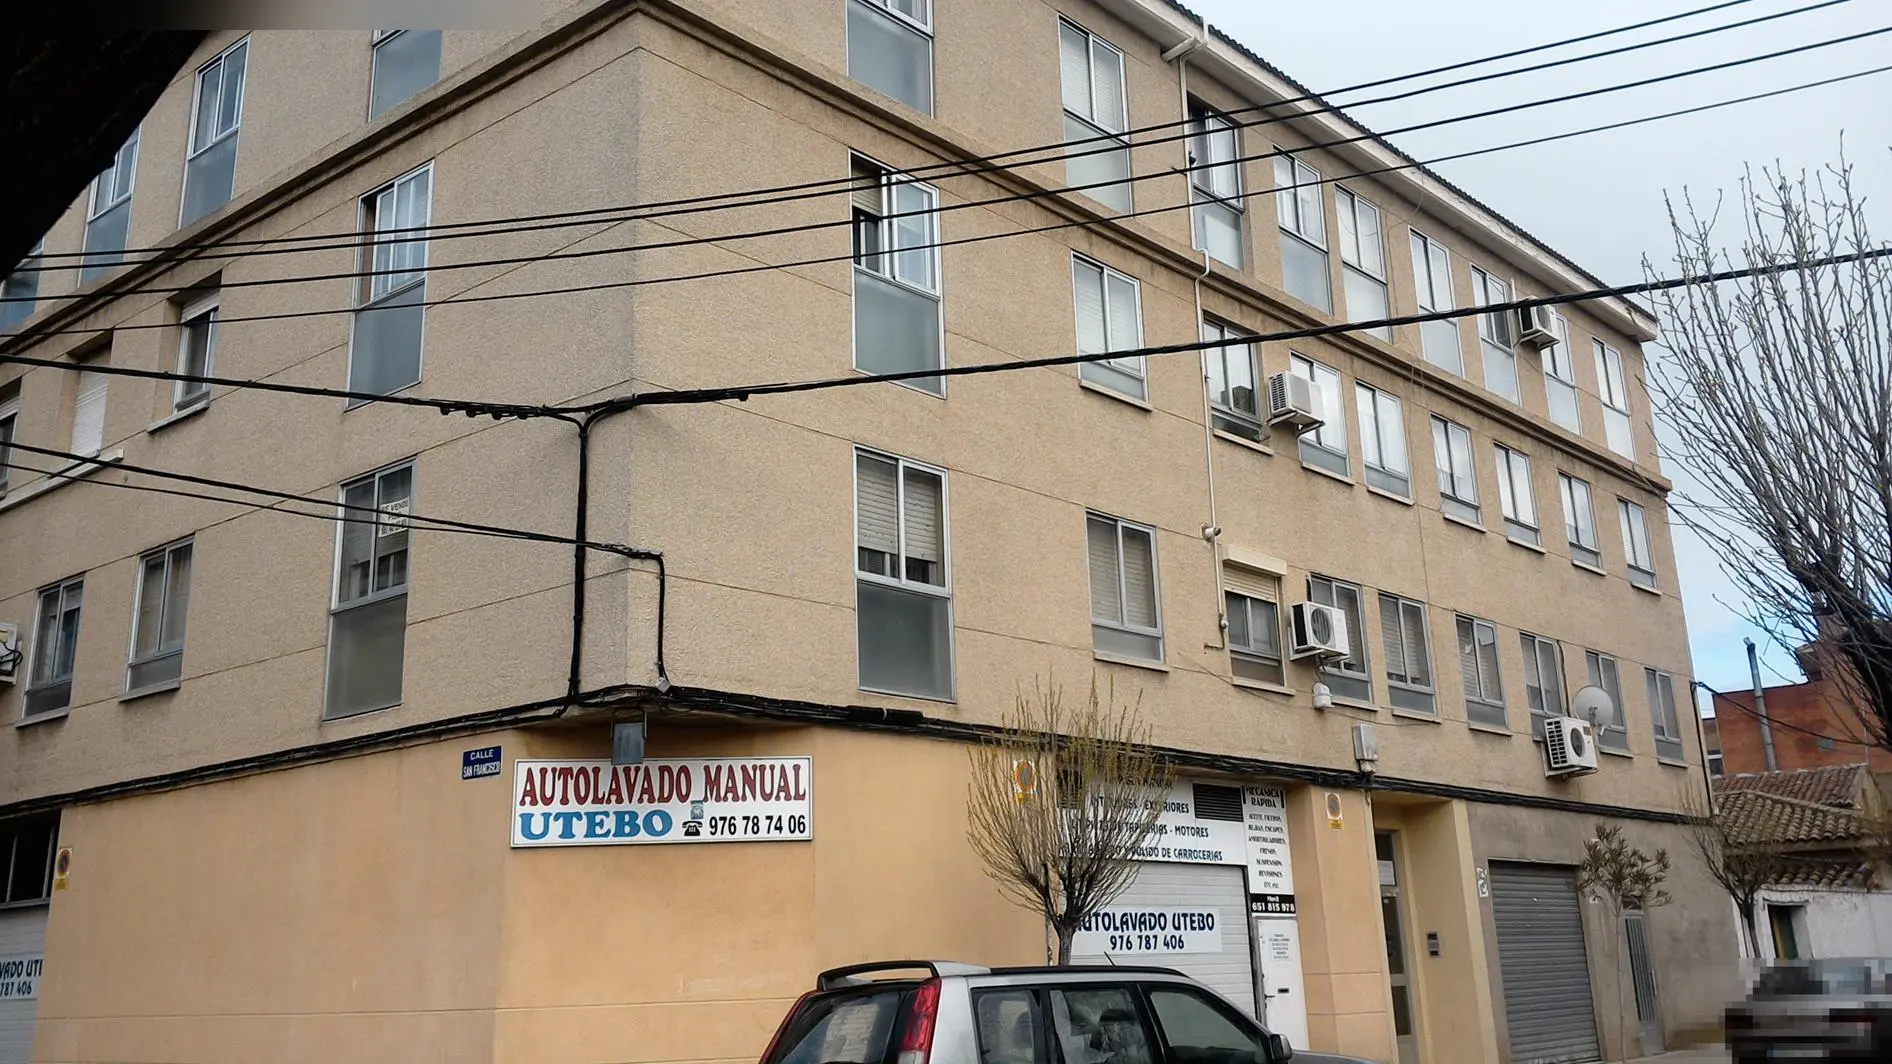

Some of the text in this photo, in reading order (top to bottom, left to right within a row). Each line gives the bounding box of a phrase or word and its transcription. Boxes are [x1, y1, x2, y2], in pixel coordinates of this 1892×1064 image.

[470, 749, 494, 760] CALLE
[463, 761, 501, 778] SAN FRANCISCO
[518, 763, 806, 806] AUTOLAVADO MANUAL
[1144, 800, 1190, 814] EXRIORES
[518, 809, 806, 841] UTEBO 976 78 74 06
[1174, 825, 1209, 838] MOTORES
[1161, 847, 1171, 858] DE
[1173, 848, 1223, 861] CARROCERIAS
[1252, 902, 1296, 912] 651 815 978
[1172, 912, 1215, 932] UTEBO
[1110, 934, 1185, 951] 976 787 406
[0, 980, 32, 996] 787 406
